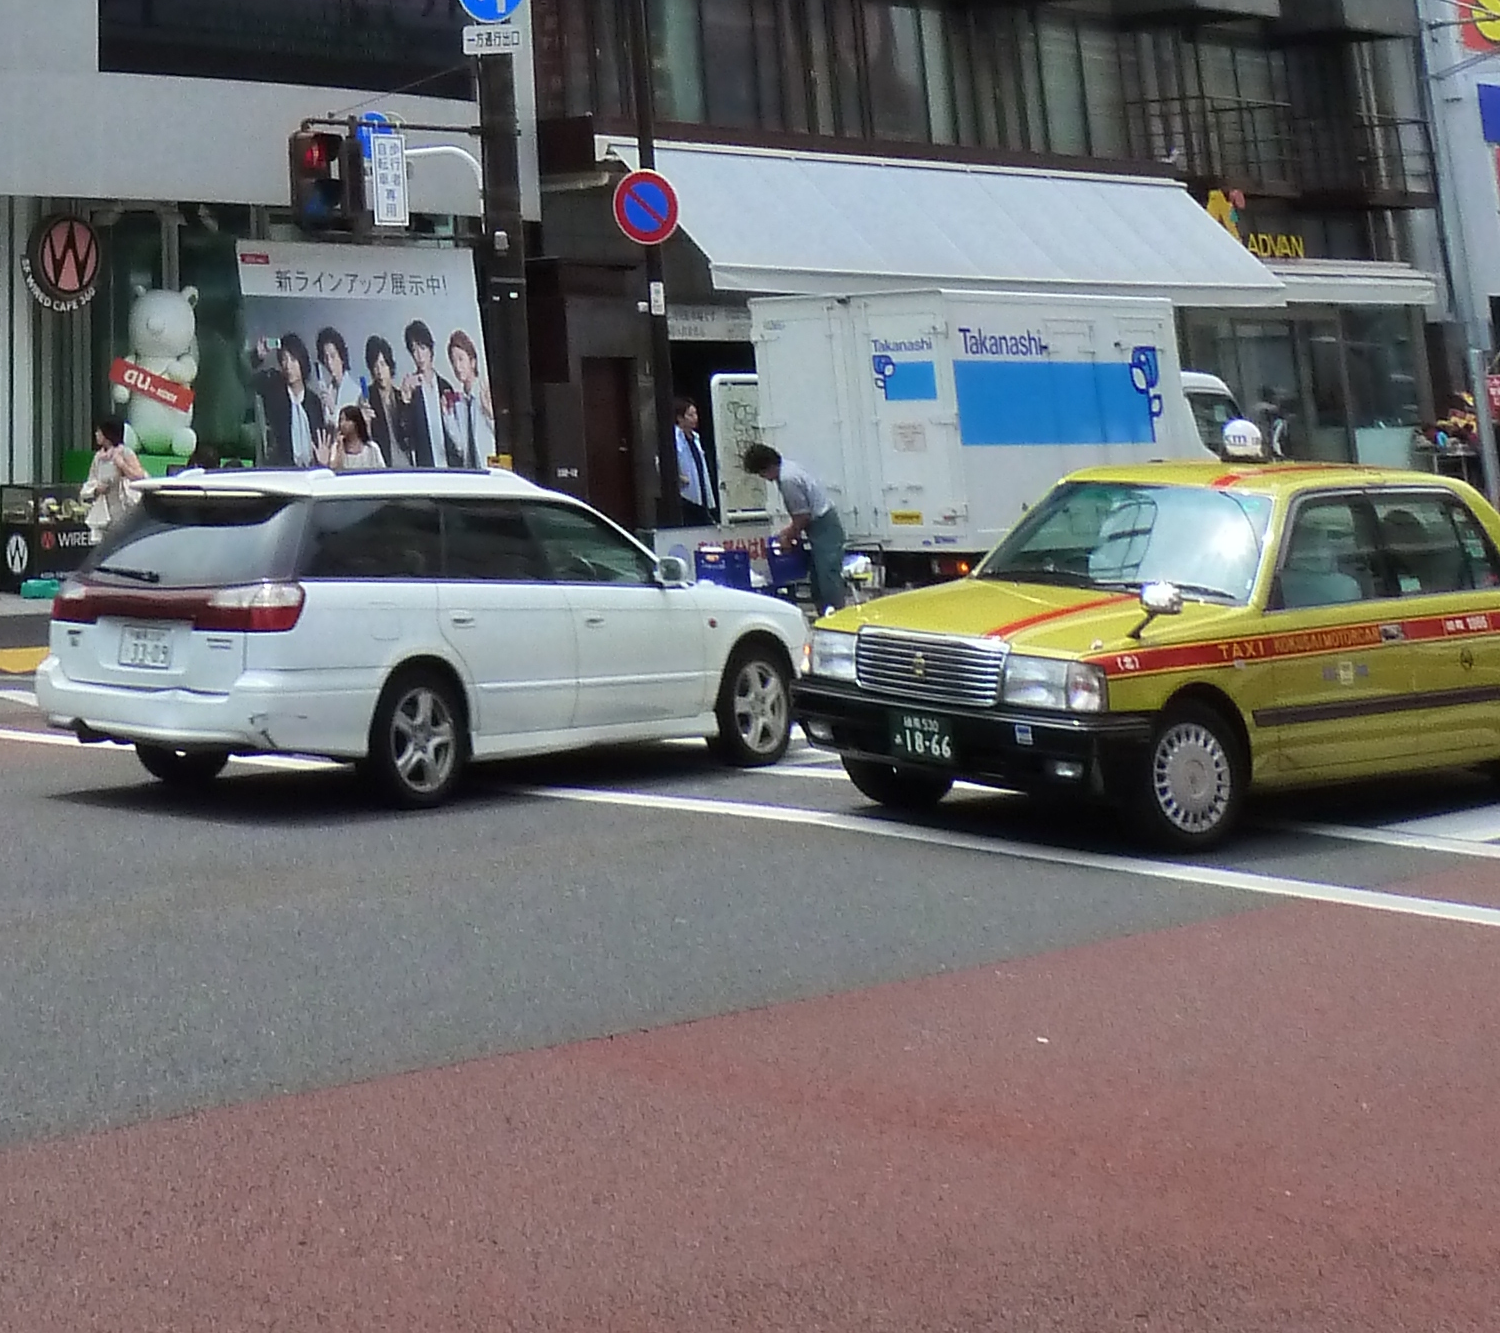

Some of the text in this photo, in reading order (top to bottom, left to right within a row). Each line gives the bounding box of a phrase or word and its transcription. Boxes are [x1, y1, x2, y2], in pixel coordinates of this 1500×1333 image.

[467, 31, 520, 48] 一方通行出口
[1248, 232, 1304, 258] ADVAN
[53, 300, 79, 312] CAFE
[871, 337, 933, 353] Takanashi
[958, 328, 1044, 356] Takanashi
[124, 369, 151, 391] au
[1218, 639, 1265, 660] TAXI
